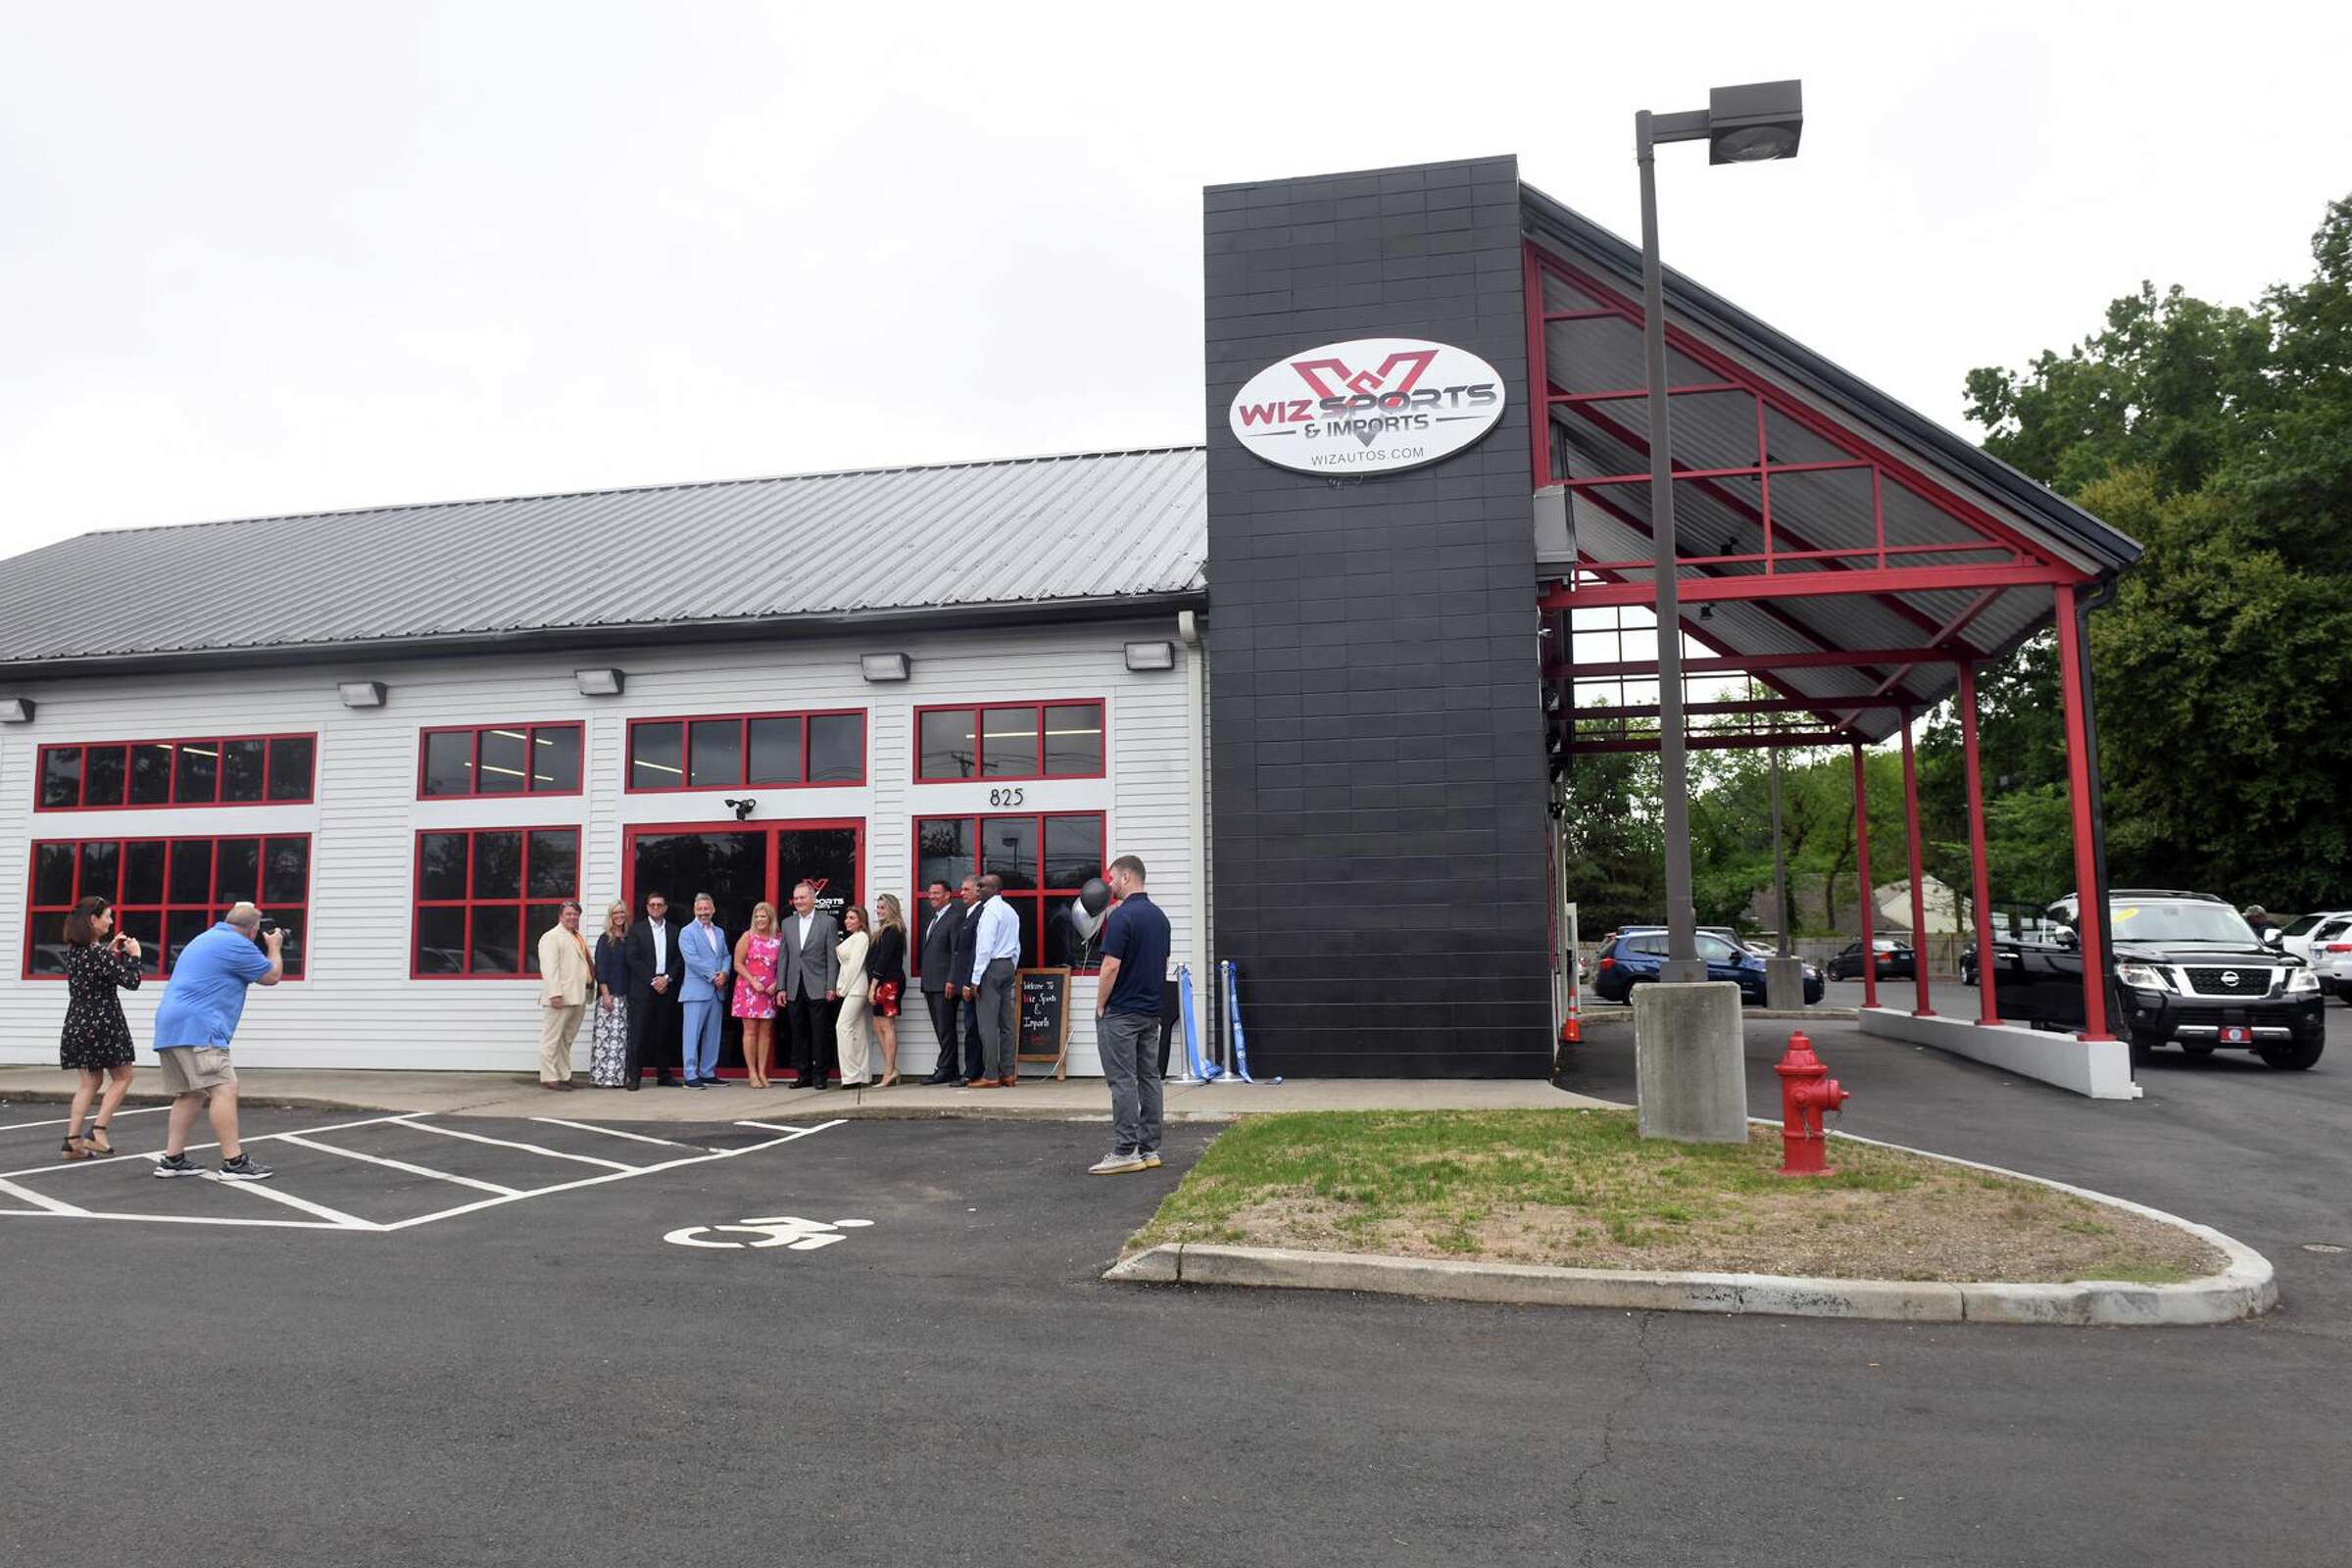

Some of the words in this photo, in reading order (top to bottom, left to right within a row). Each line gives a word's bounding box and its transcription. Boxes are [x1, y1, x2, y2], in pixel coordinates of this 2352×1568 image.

[1239, 399, 1314, 426] WIZ
[1319, 383, 1497, 417] SPORTS
[1304, 423, 1321, 439] &
[1328, 414, 1429, 437] IMPORTS
[1311, 447, 1424, 466] WIZAUTOS.COM
[990, 788, 1023, 807] 825
